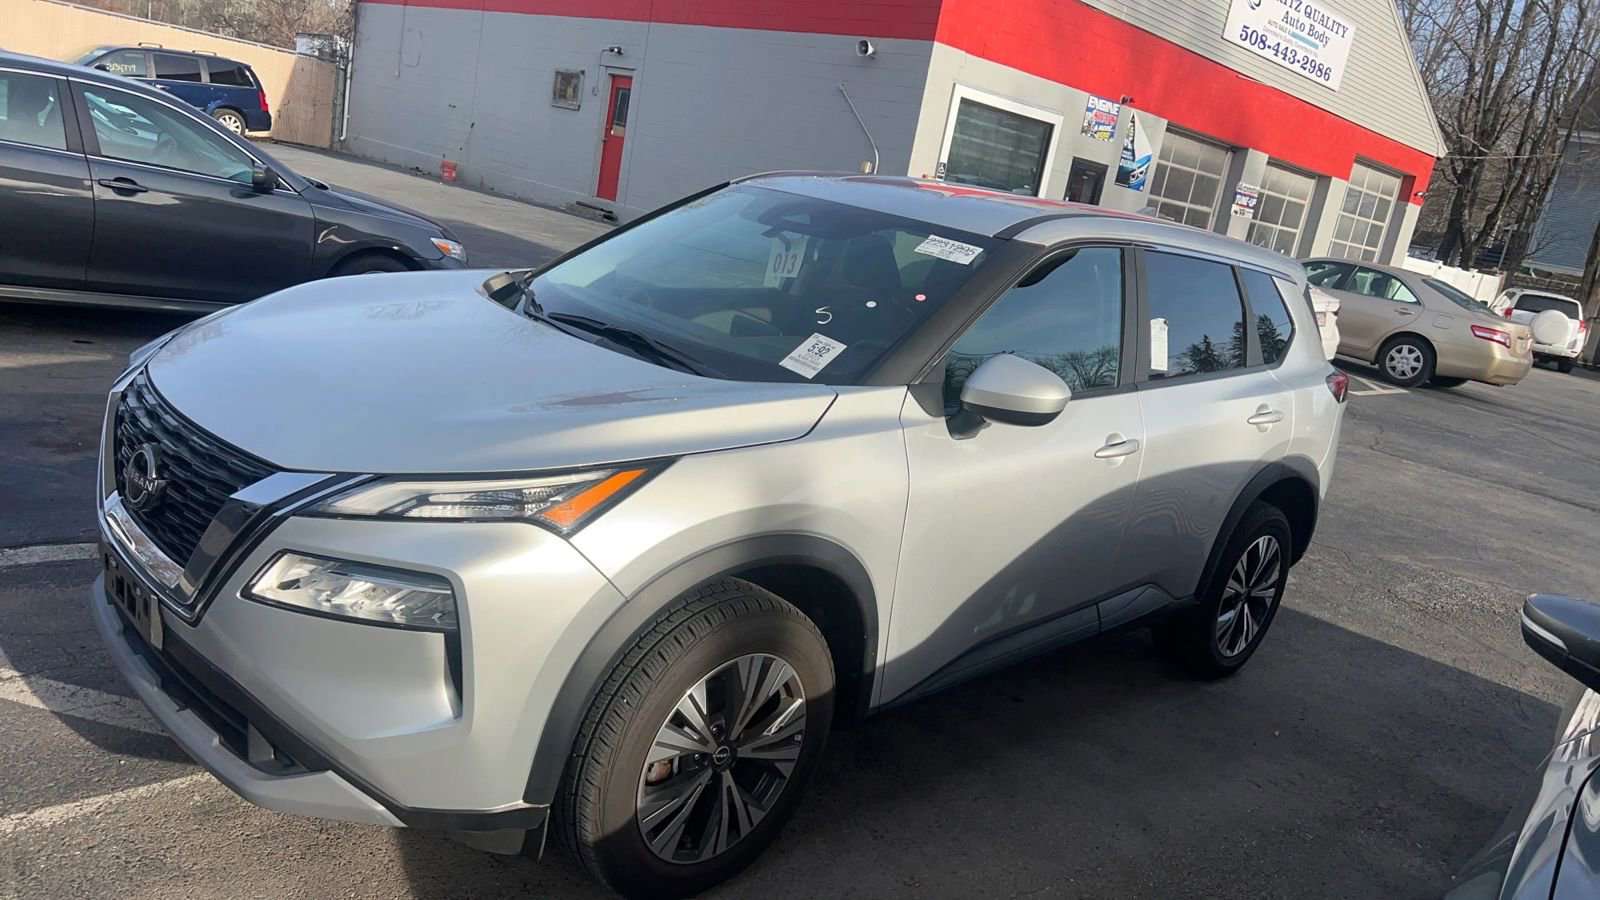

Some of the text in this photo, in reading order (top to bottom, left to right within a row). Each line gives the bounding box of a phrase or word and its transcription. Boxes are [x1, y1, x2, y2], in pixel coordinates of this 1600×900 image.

[1281, 10, 1306, 32] Auto
[1307, 23, 1330, 48] Body
[1304, 4, 1349, 39] QUALITY
[1239, 25, 1333, 82] 508-443-2986
[1088, 95, 1121, 116] ENGINE
[774, 252, 798, 274] 013
[123, 466, 154, 491] NSSAN
